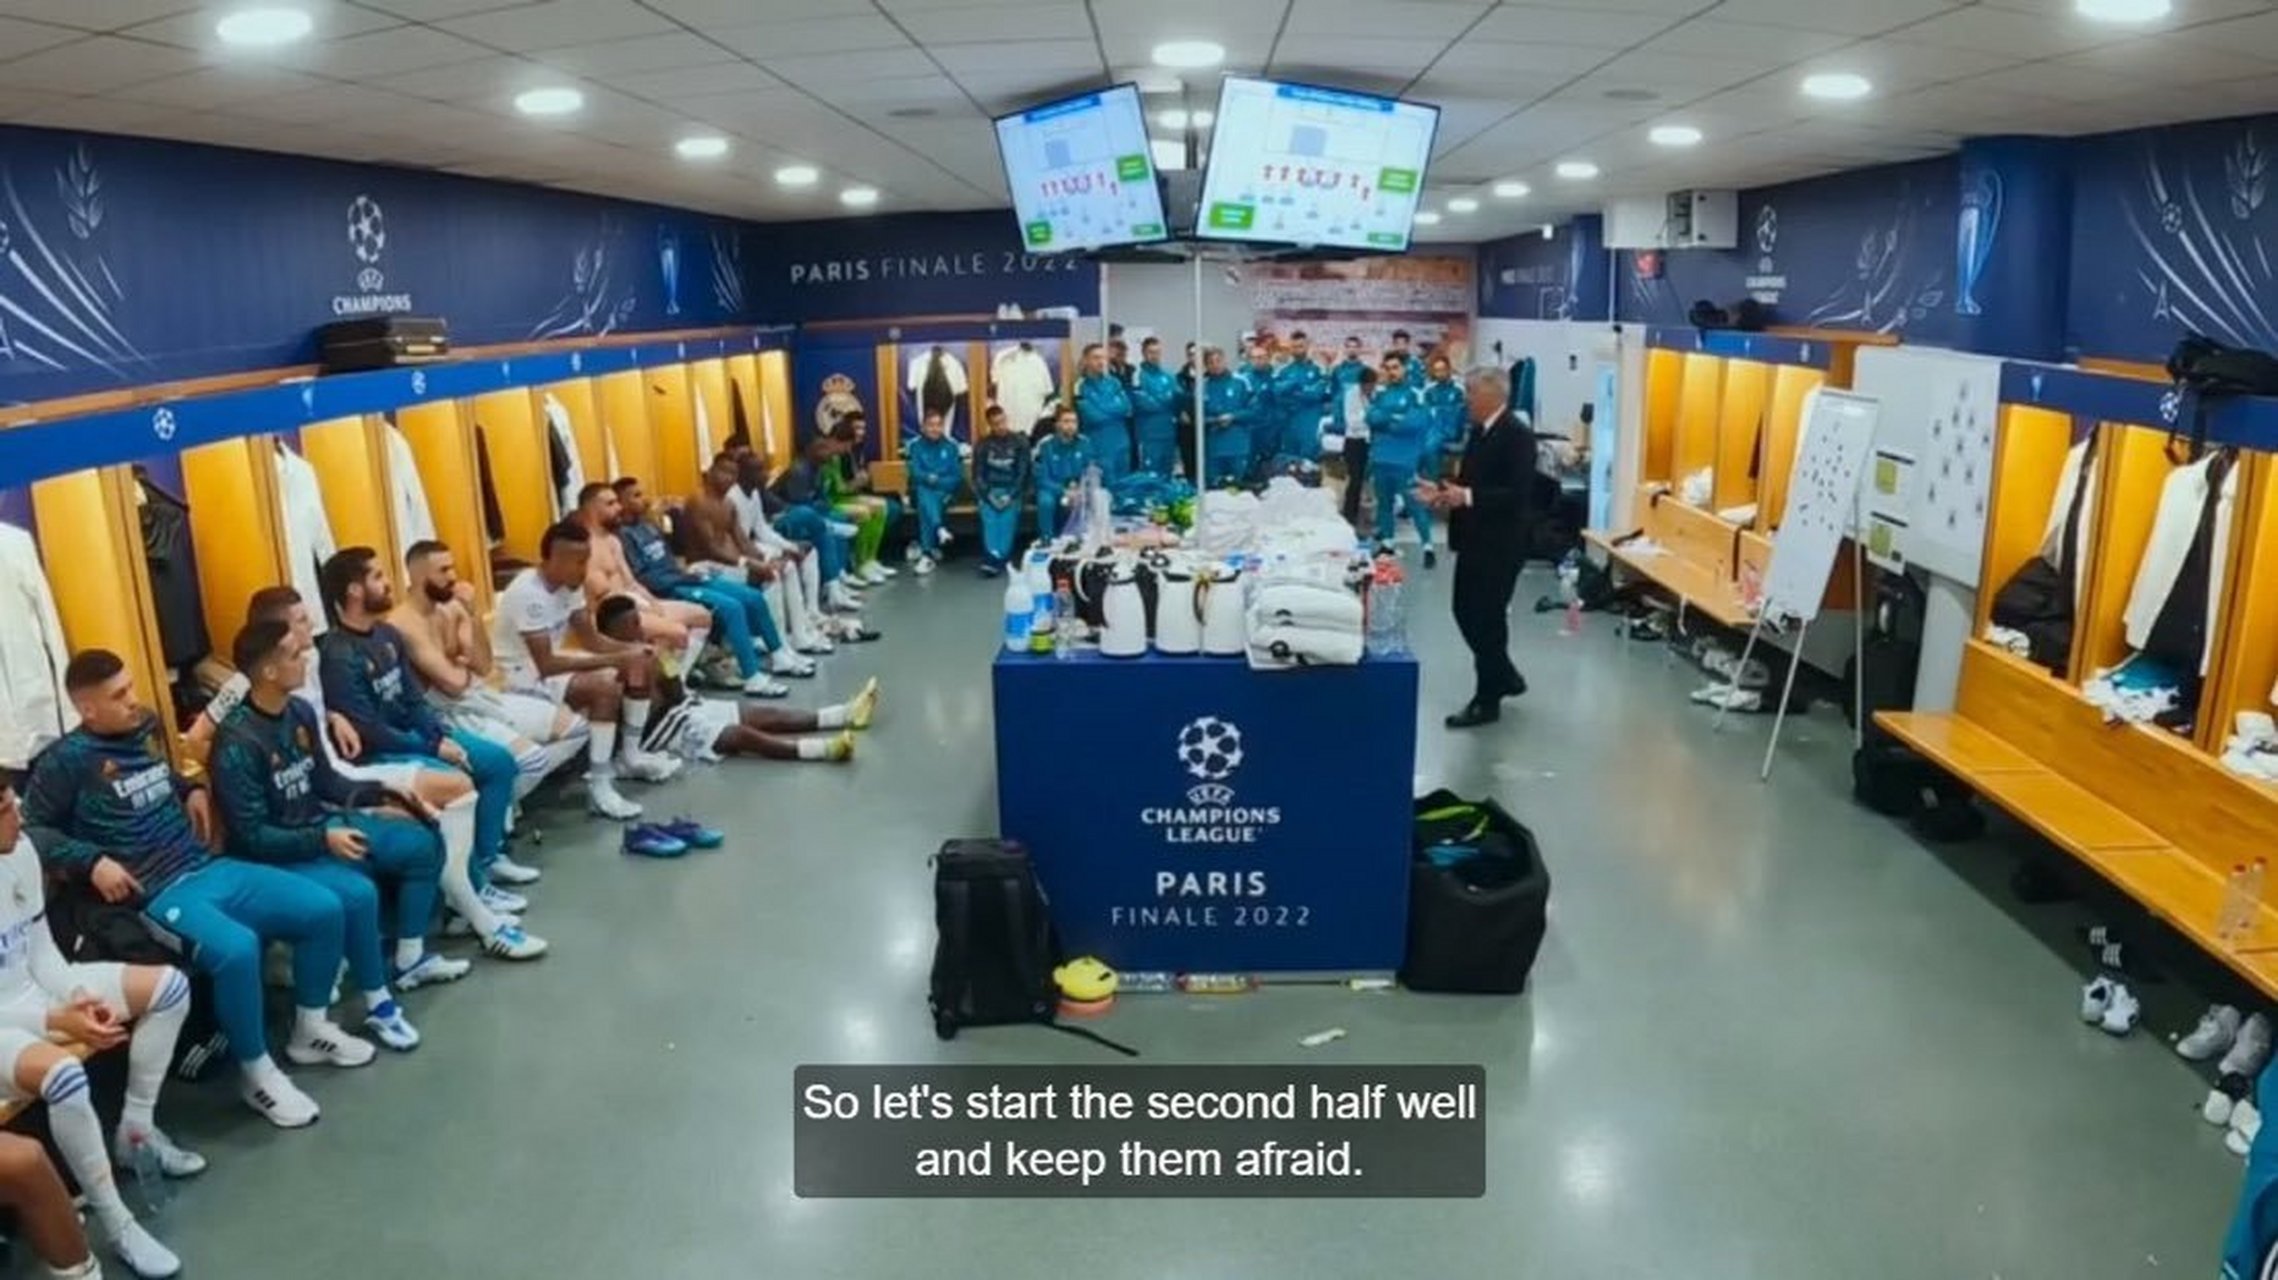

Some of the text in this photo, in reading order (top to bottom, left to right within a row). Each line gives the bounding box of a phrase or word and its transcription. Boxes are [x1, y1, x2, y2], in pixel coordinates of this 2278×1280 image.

[790, 260, 869, 283] PARIS
[881, 252, 986, 279] FINALE
[332, 294, 412, 315] CHAMPIONS
[112, 761, 170, 799] Emirates
[1187, 783, 1236, 806] UEFA
[1141, 807, 1281, 824] CHAMPIONS
[1166, 826, 1257, 843] LEAGUE
[1156, 871, 1267, 897] PARIS
[1111, 906, 1310, 927] FINALE 2022
